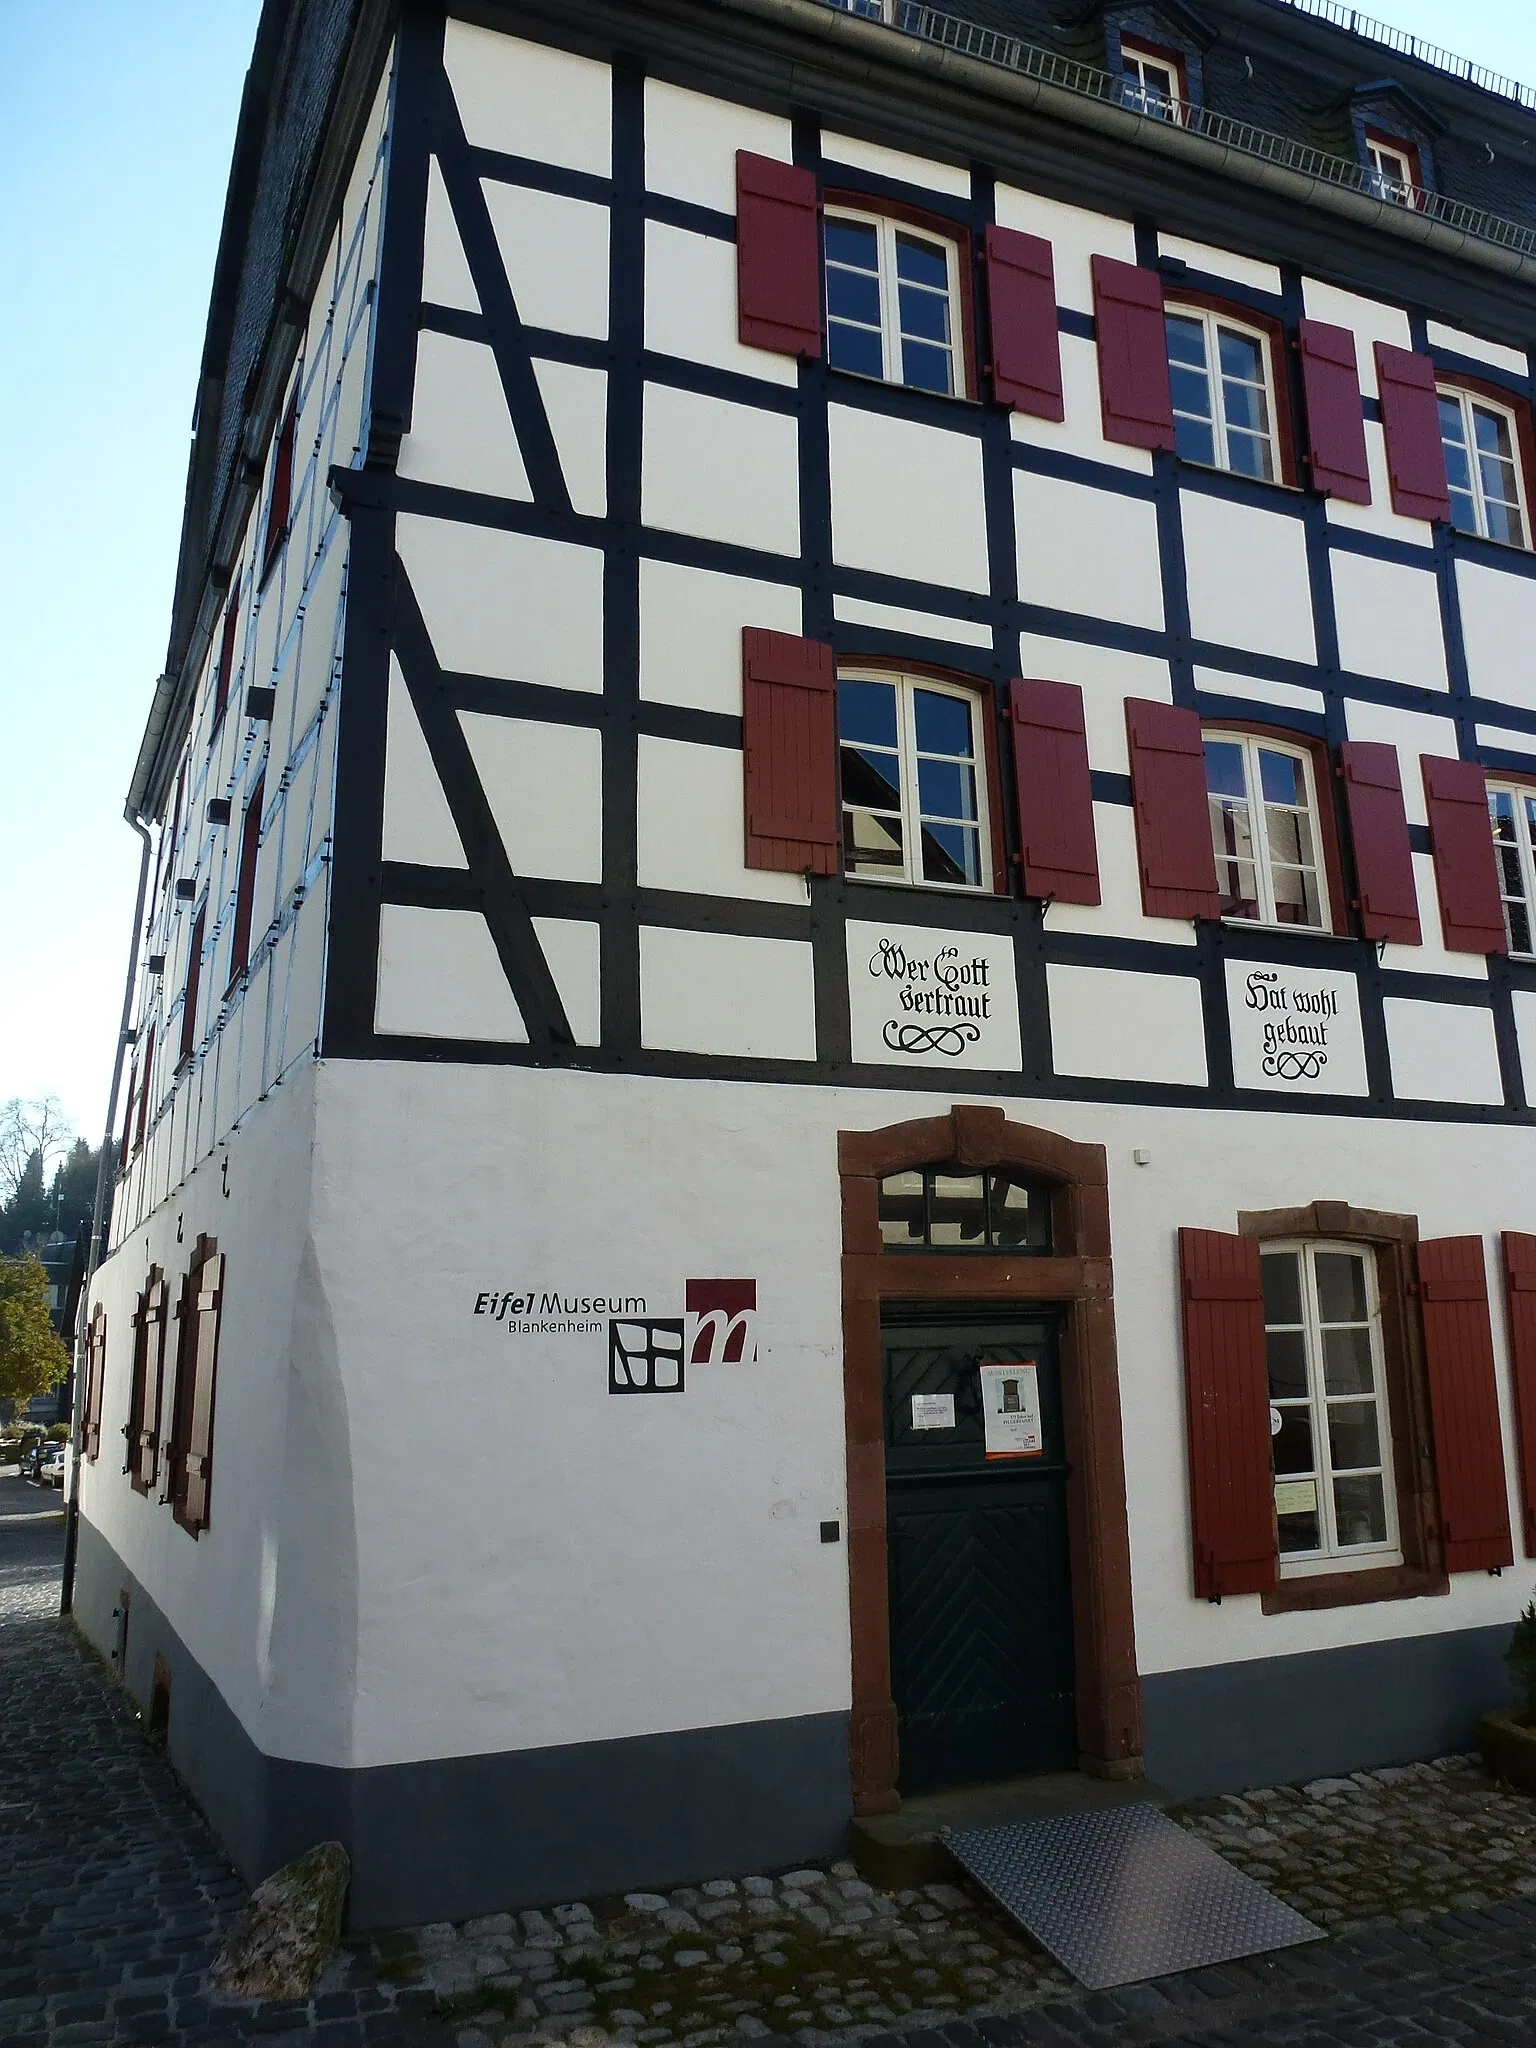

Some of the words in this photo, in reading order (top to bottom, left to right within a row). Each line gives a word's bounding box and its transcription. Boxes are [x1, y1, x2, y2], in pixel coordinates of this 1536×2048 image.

[869, 938, 930, 982] Wer
[933, 945, 990, 992] Gott
[1245, 970, 1288, 1012] Hat
[1292, 987, 1339, 1021] wohl
[1263, 1015, 1329, 1055] gebaut
[473, 1291, 536, 1321] Eifel
[539, 1292, 648, 1314] Museum
[508, 1319, 602, 1333] Blankenheim
